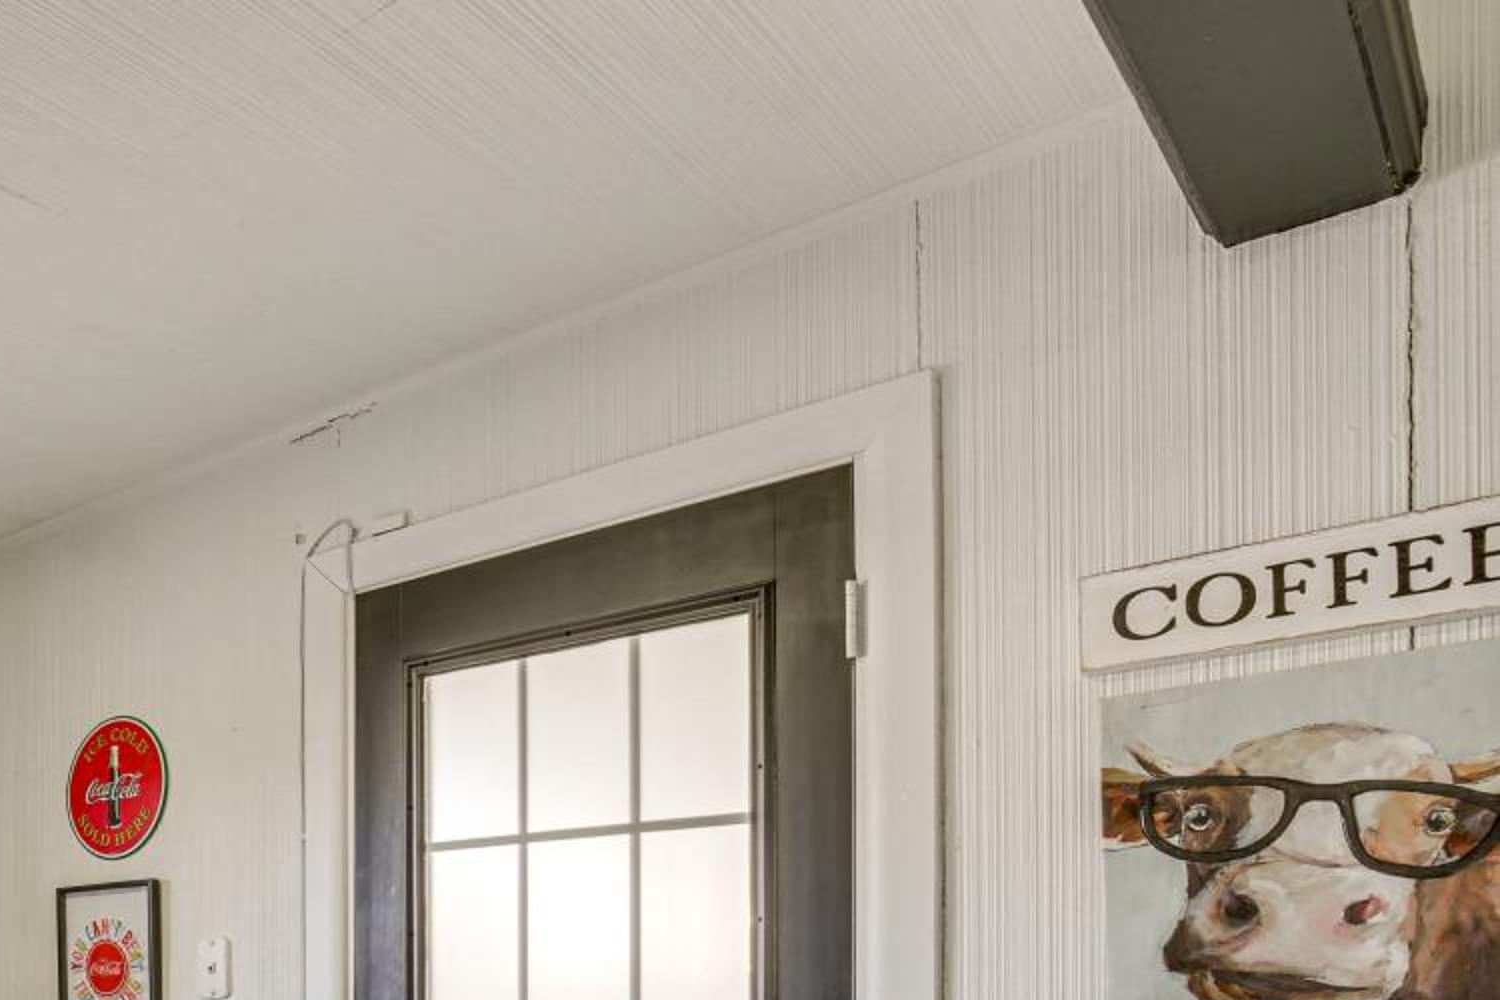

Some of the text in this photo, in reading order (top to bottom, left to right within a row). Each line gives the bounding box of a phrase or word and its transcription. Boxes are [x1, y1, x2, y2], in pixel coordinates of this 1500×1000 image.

[83, 727, 150, 763] ICE COLD
[77, 808, 151, 846] SOLD HERE
